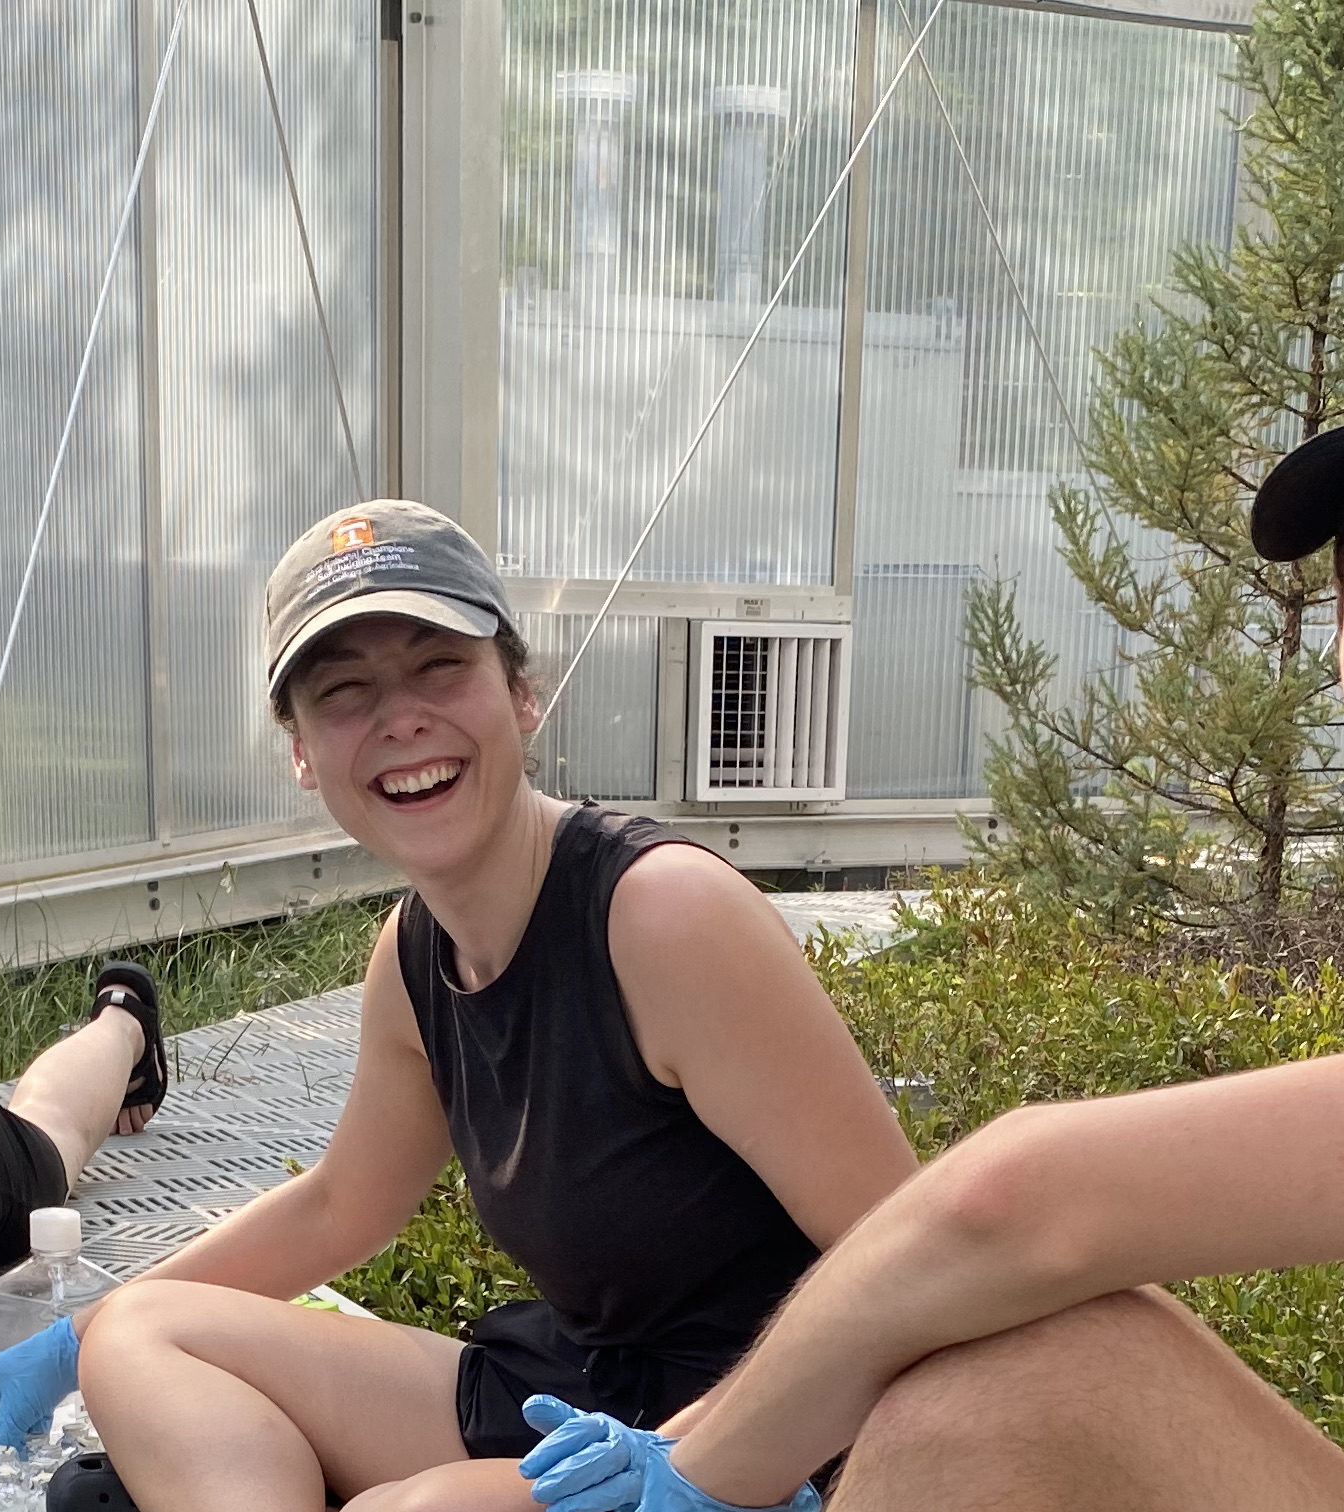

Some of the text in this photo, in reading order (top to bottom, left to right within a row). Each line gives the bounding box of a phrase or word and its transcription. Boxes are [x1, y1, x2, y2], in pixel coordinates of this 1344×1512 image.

[337, 521, 367, 546] T
[336, 557, 373, 574] Judging
[375, 552, 402, 563] Team
